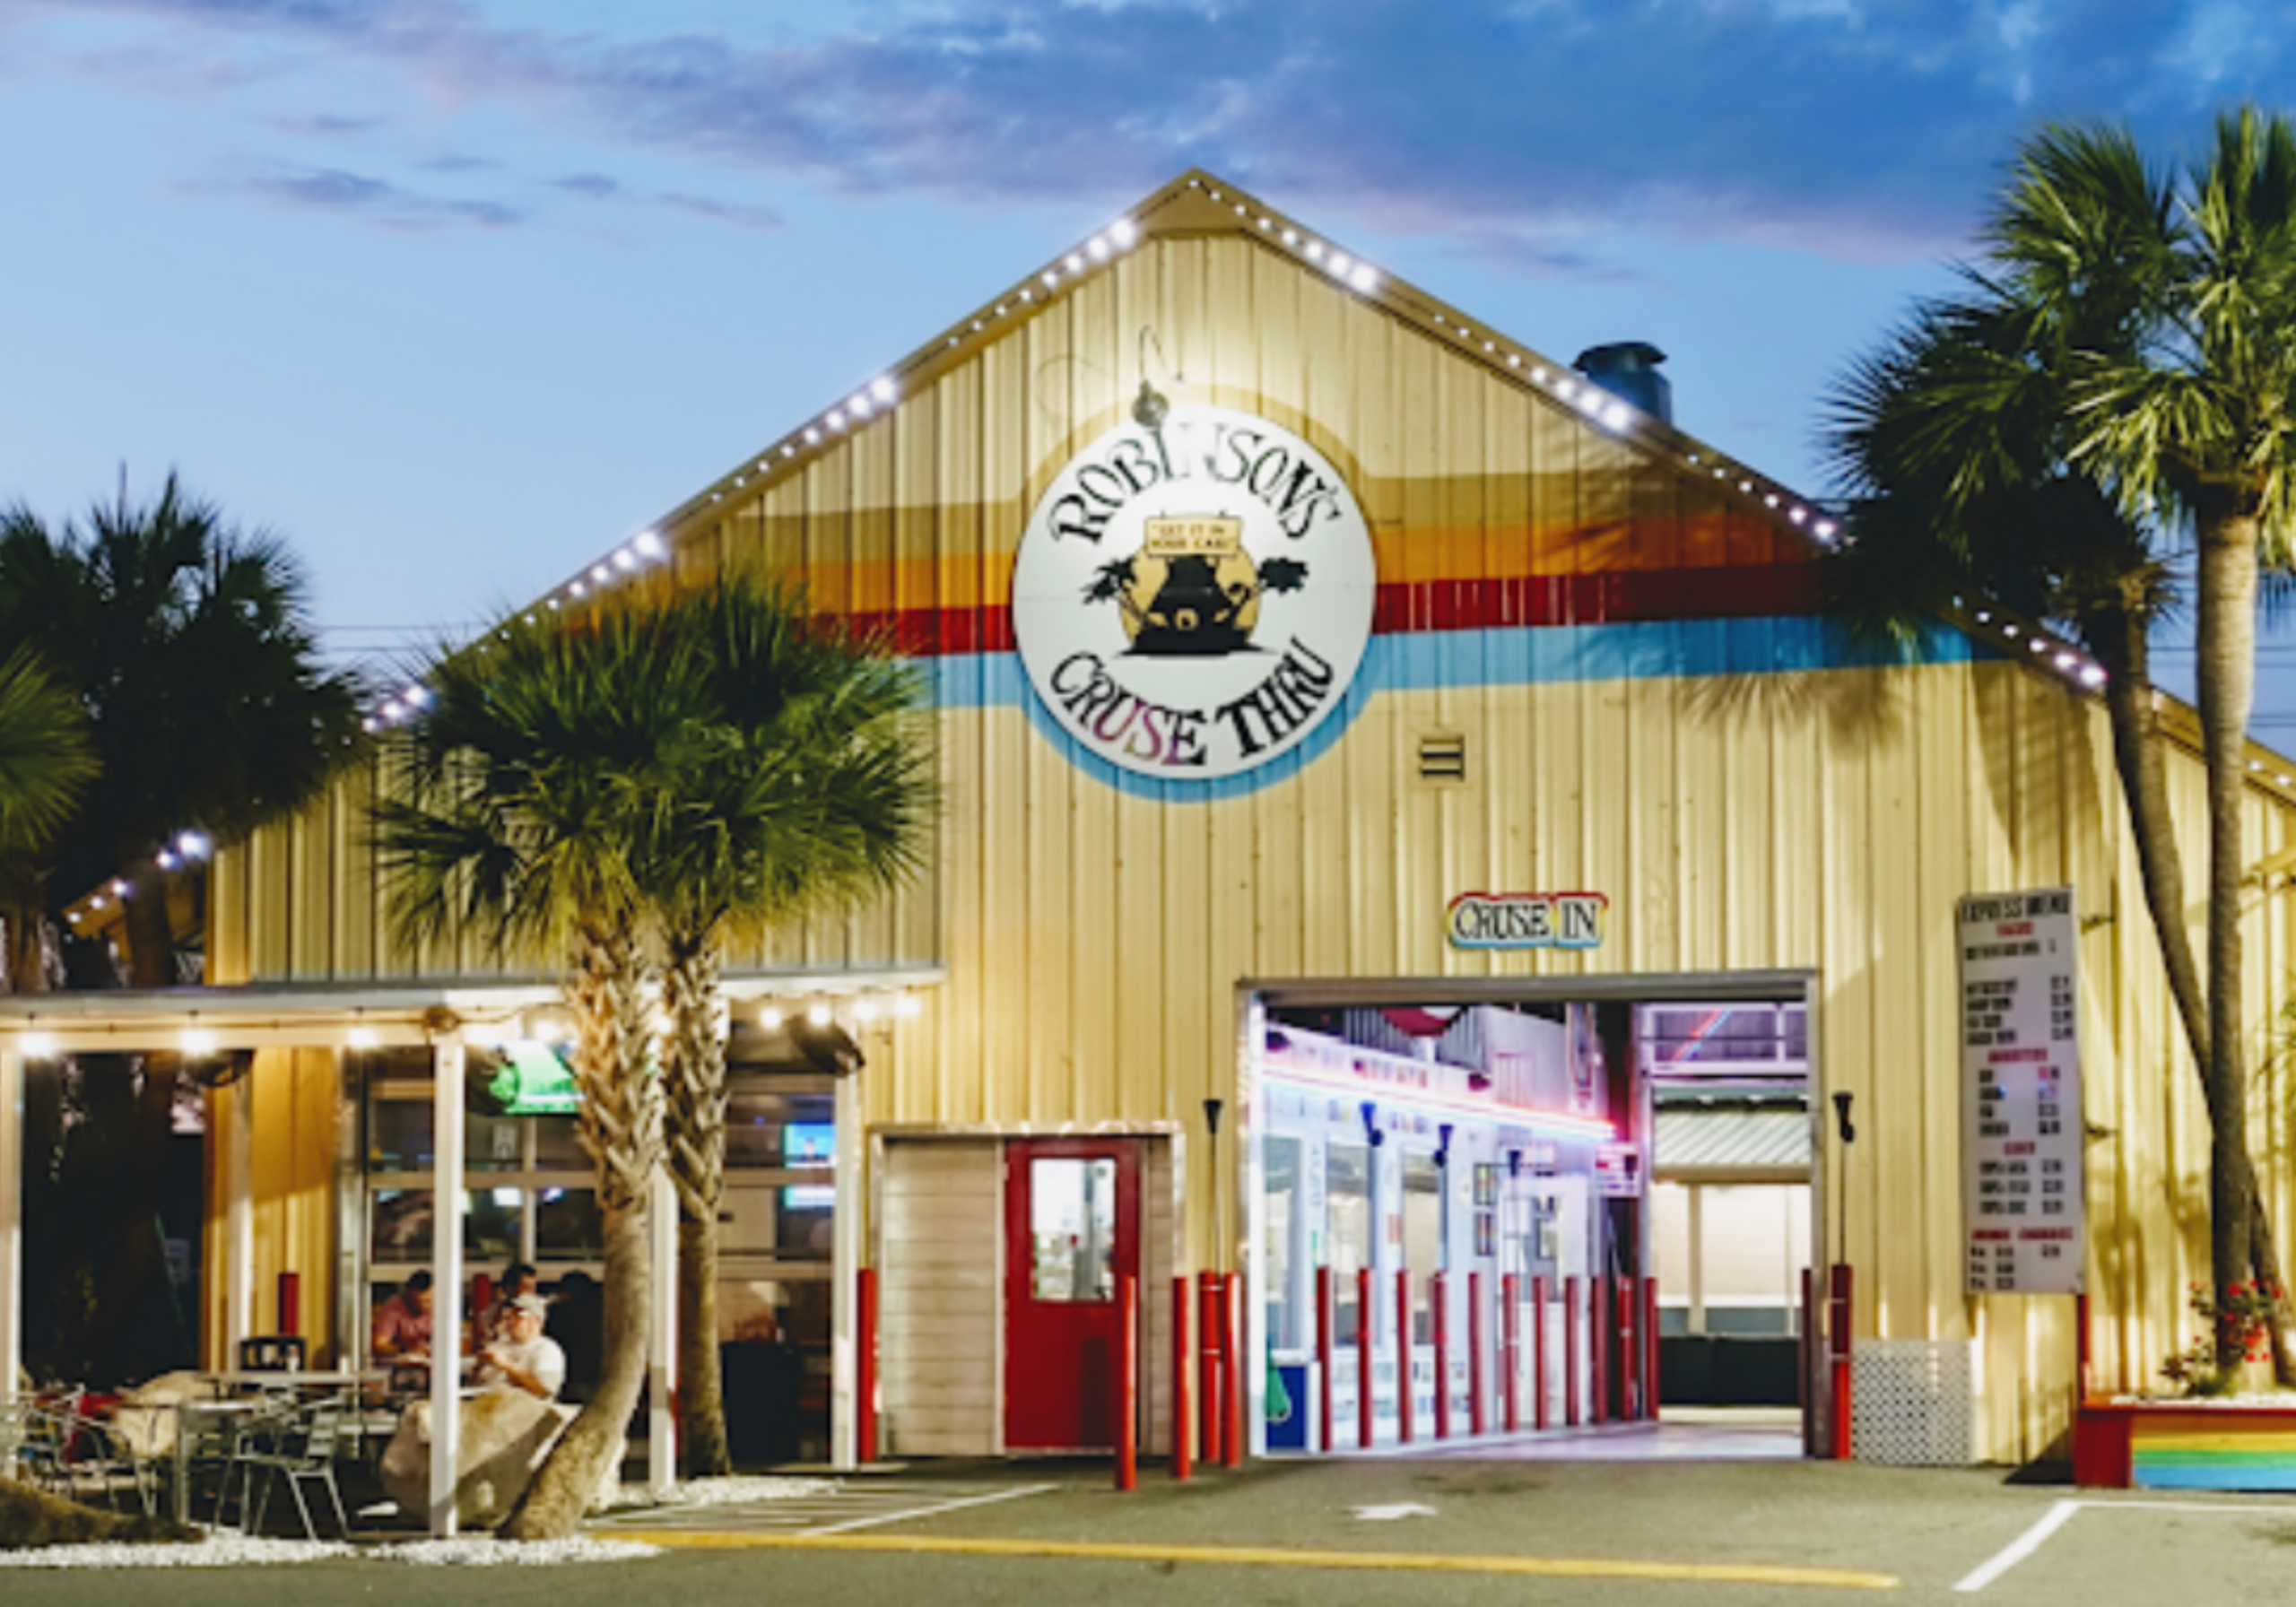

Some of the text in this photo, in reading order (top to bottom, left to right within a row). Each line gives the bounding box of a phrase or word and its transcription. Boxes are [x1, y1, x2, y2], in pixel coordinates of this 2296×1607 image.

[1050, 635, 1335, 767] CRUSE THRU
[1455, 900, 1599, 940] CRUSE IN
